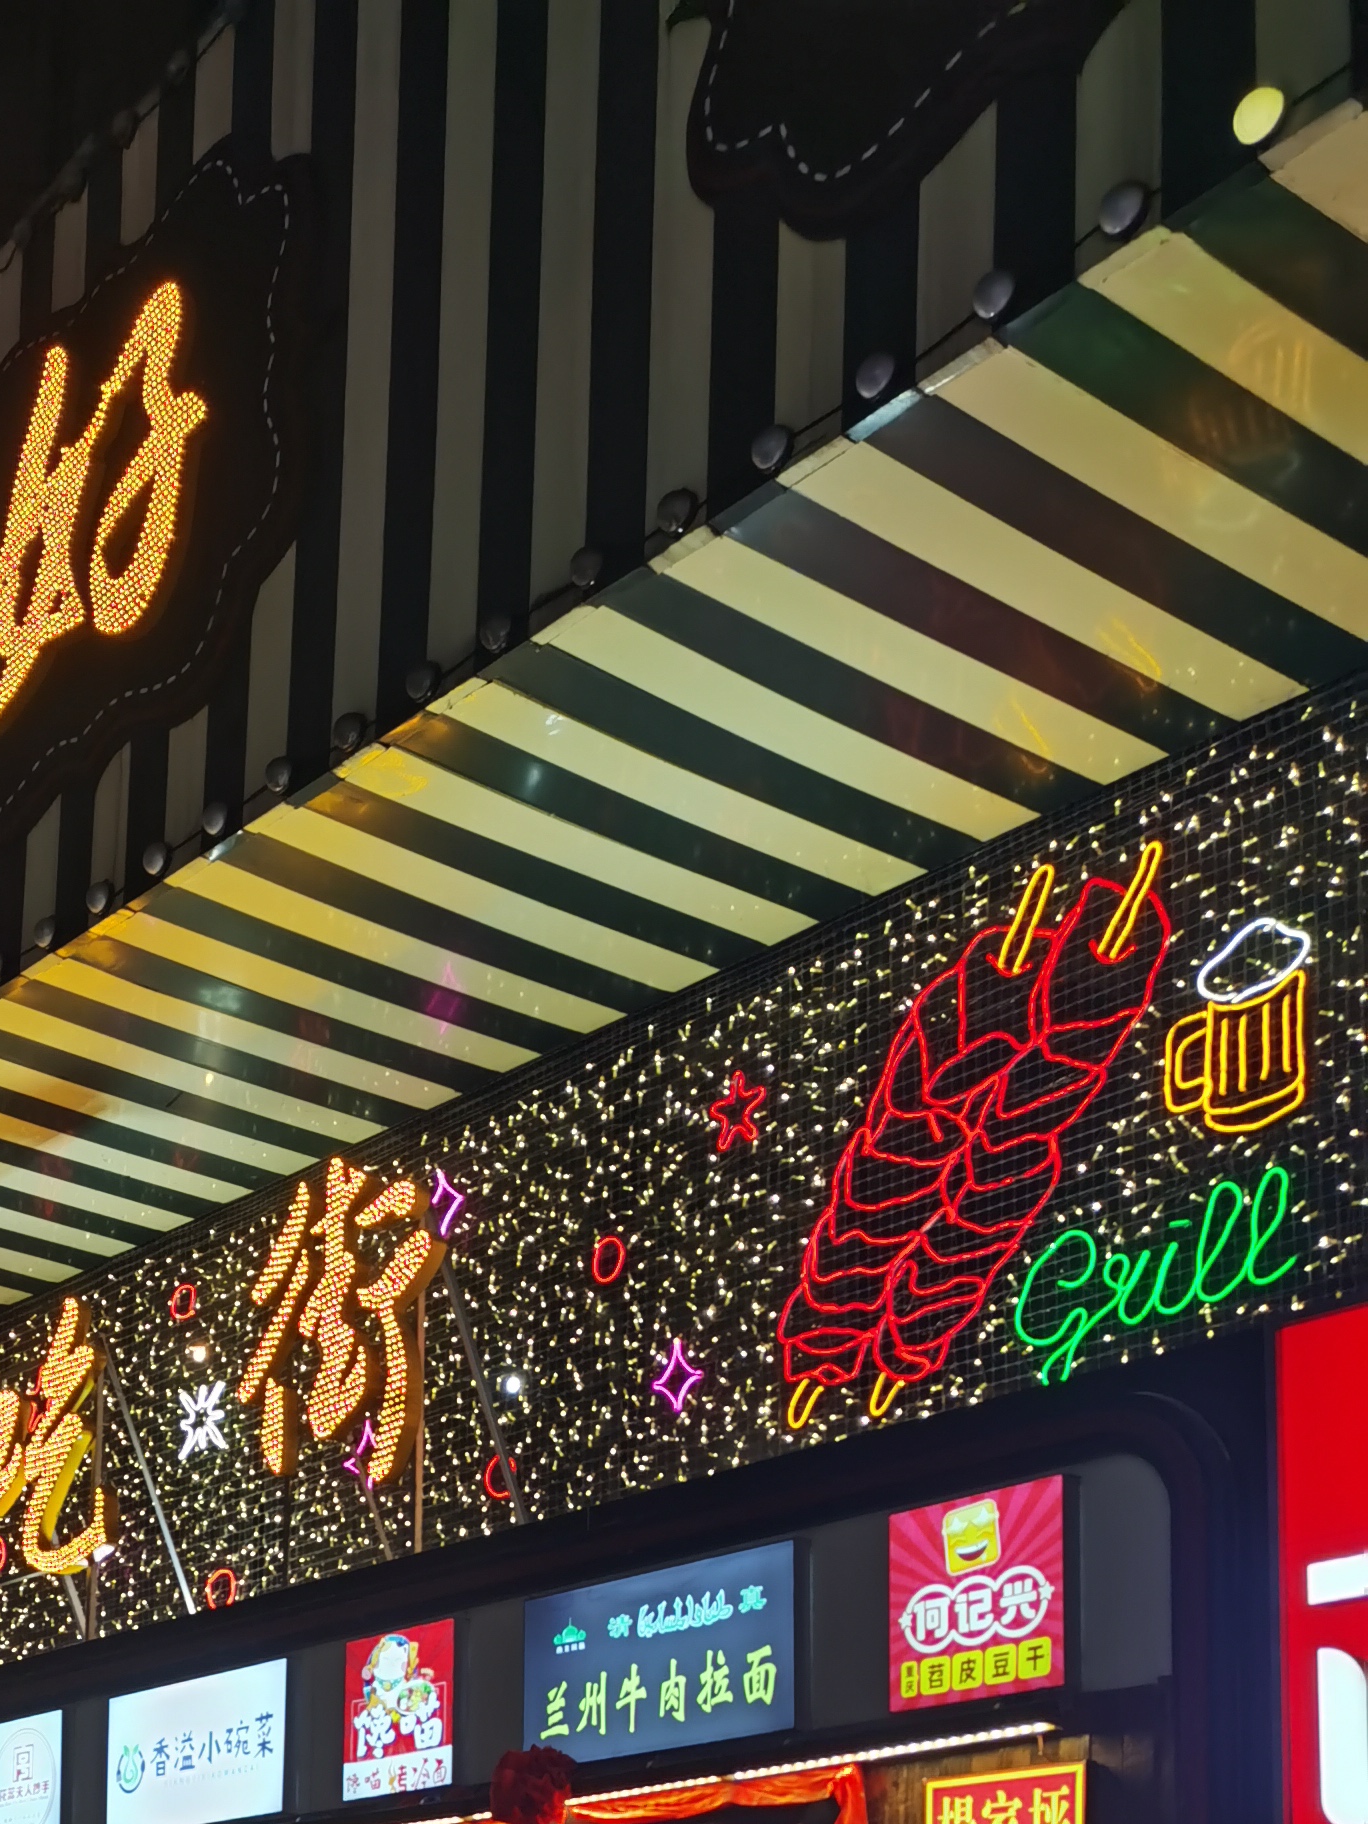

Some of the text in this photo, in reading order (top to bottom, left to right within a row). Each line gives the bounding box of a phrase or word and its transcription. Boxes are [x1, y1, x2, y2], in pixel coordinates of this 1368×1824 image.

[1015, 1167, 1295, 1385] Grill
[914, 1579, 1039, 1640] 何记兴
[540, 1644, 777, 1740] 兰州牛肉拉面
[927, 1642, 1047, 1690] 苕皮豆干
[150, 1712, 275, 1778] 香溢小碗菜
[353, 1700, 442, 1758] 馋喵
